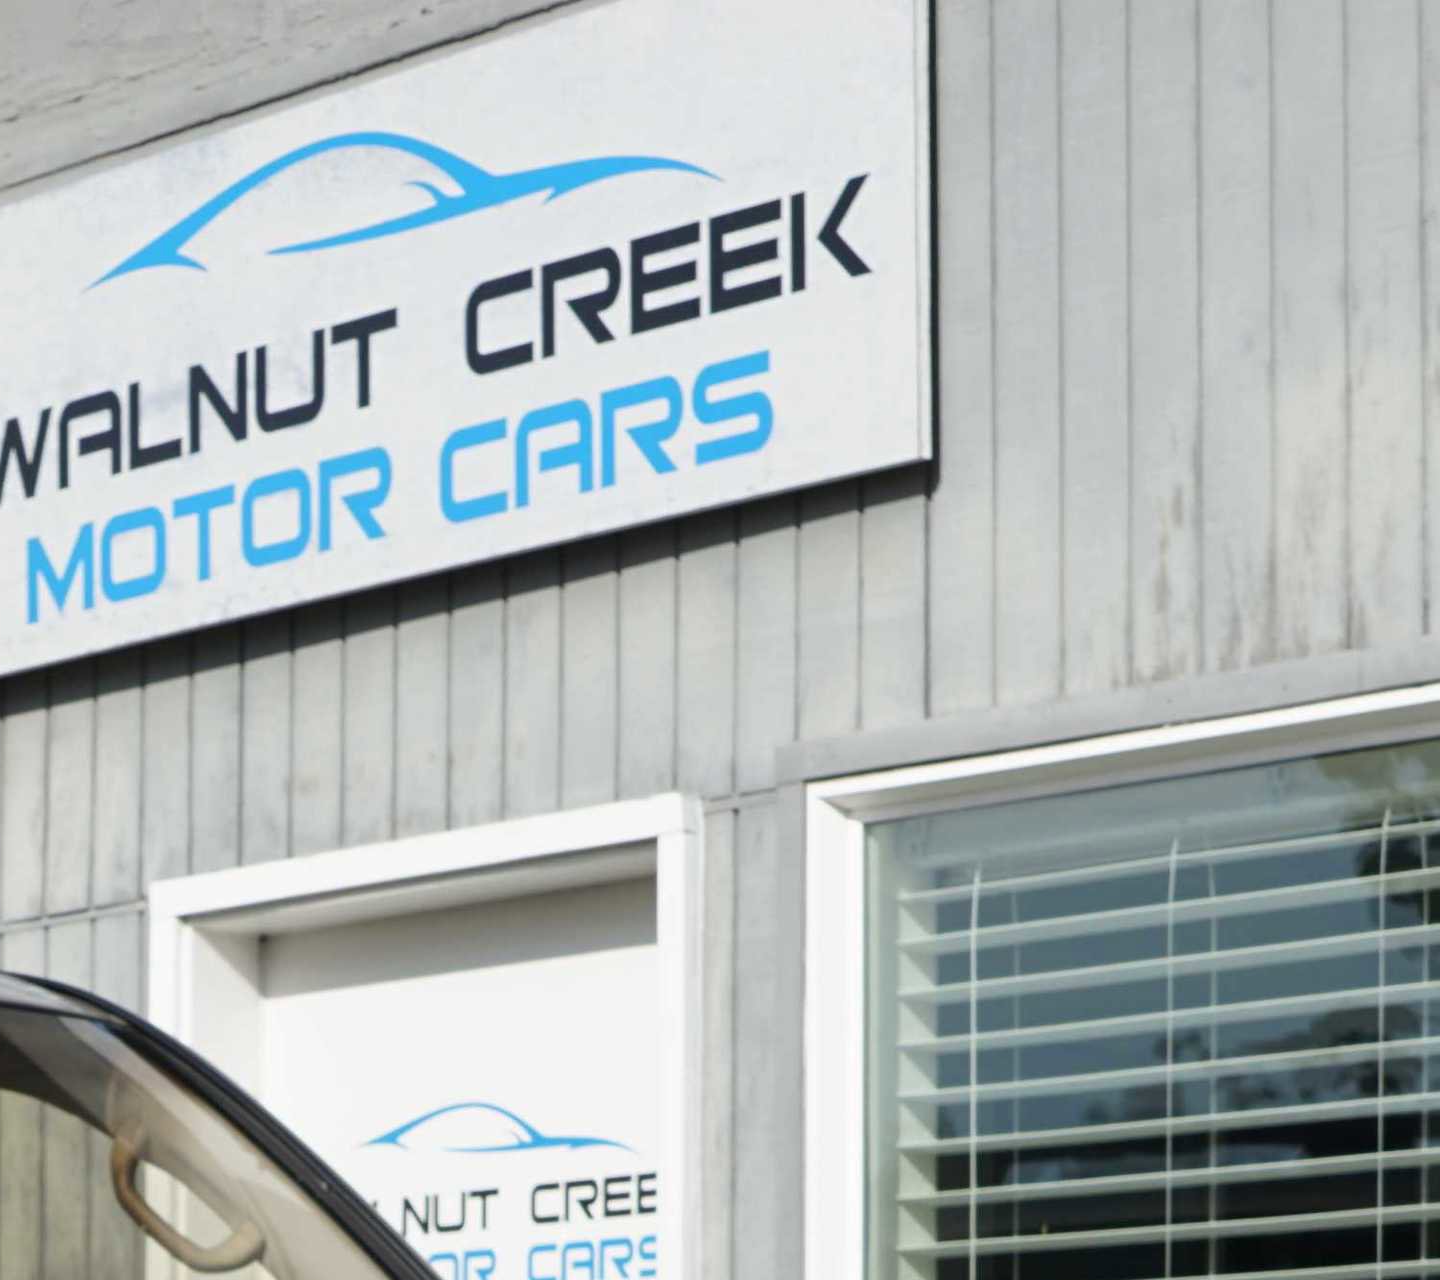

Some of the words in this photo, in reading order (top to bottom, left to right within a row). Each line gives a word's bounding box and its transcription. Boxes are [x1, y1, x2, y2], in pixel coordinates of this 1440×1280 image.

[465, 173, 872, 375] CREEK
[25, 446, 392, 624] MOTOR
[439, 349, 773, 525] CARS
[372, 1188, 499, 1237] NUT
[530, 1172, 657, 1224] CREE
